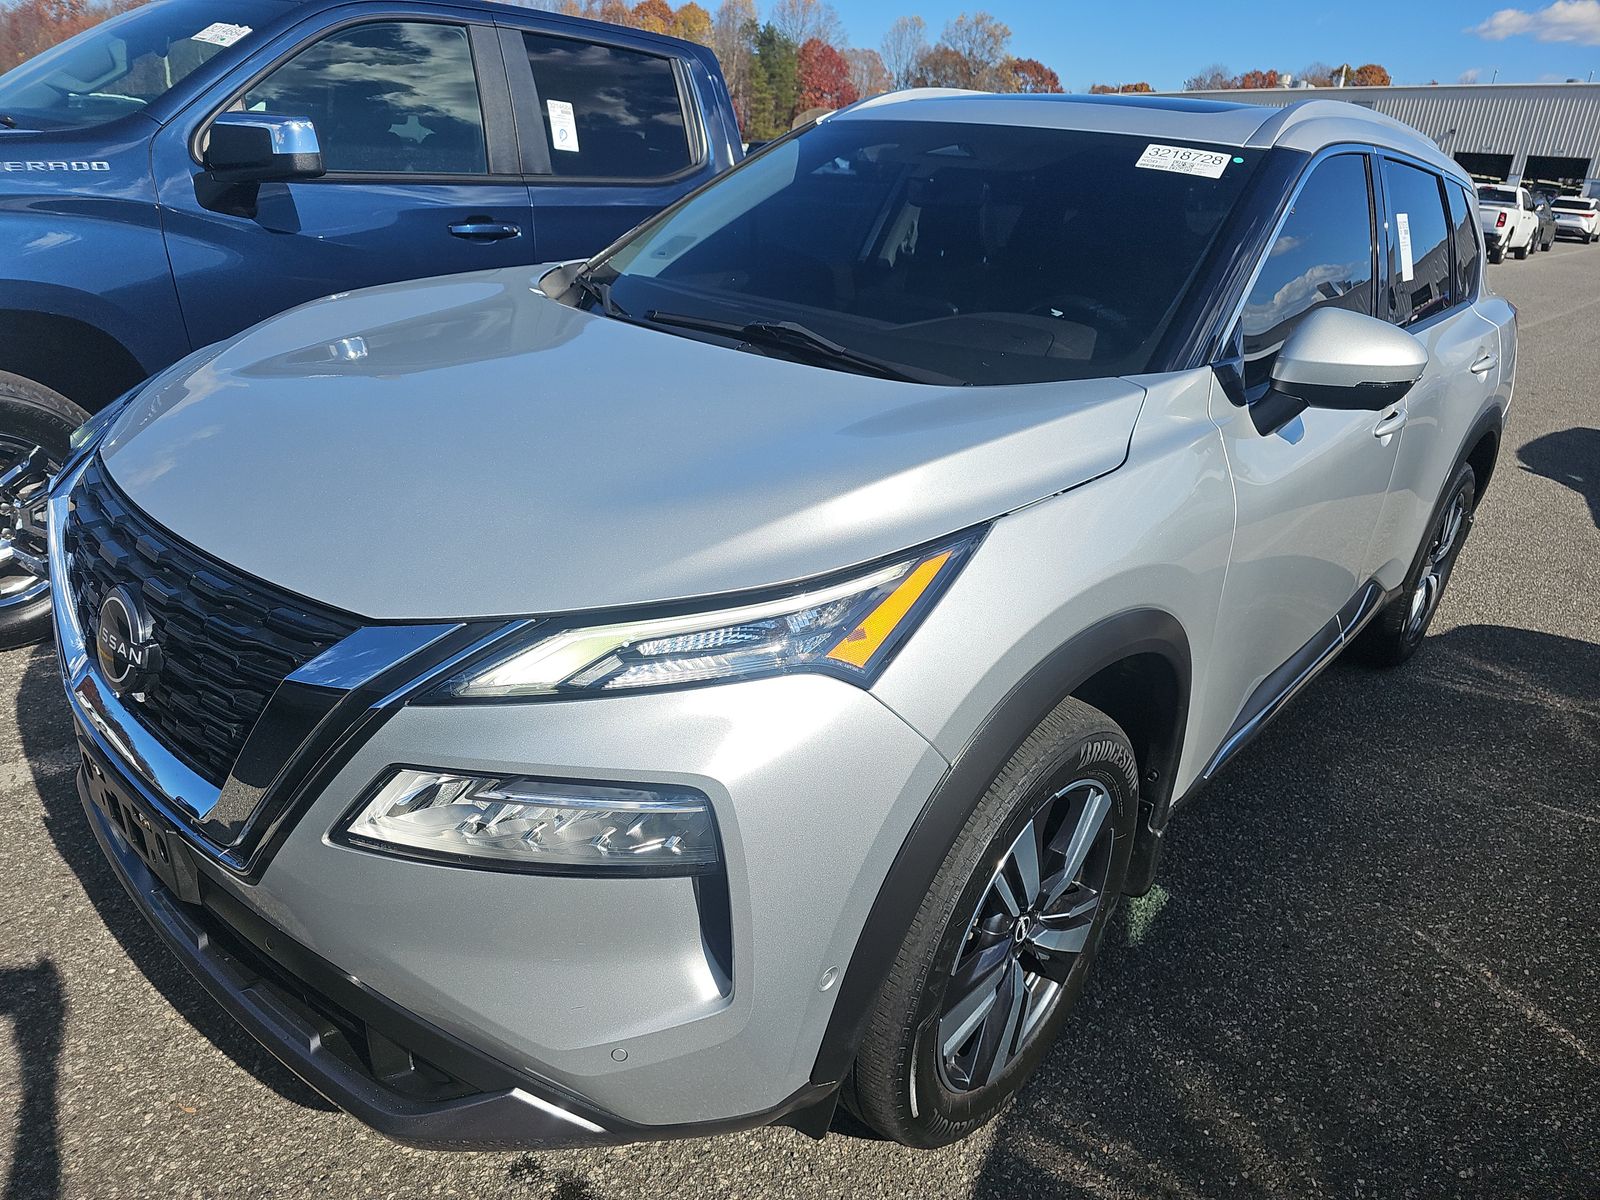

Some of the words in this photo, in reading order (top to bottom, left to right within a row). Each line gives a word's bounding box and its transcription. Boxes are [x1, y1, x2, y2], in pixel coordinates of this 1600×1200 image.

[1148, 147, 1224, 166] 3218728
[0, 161, 111, 172] ERADO
[101, 627, 143, 665] SSAN
